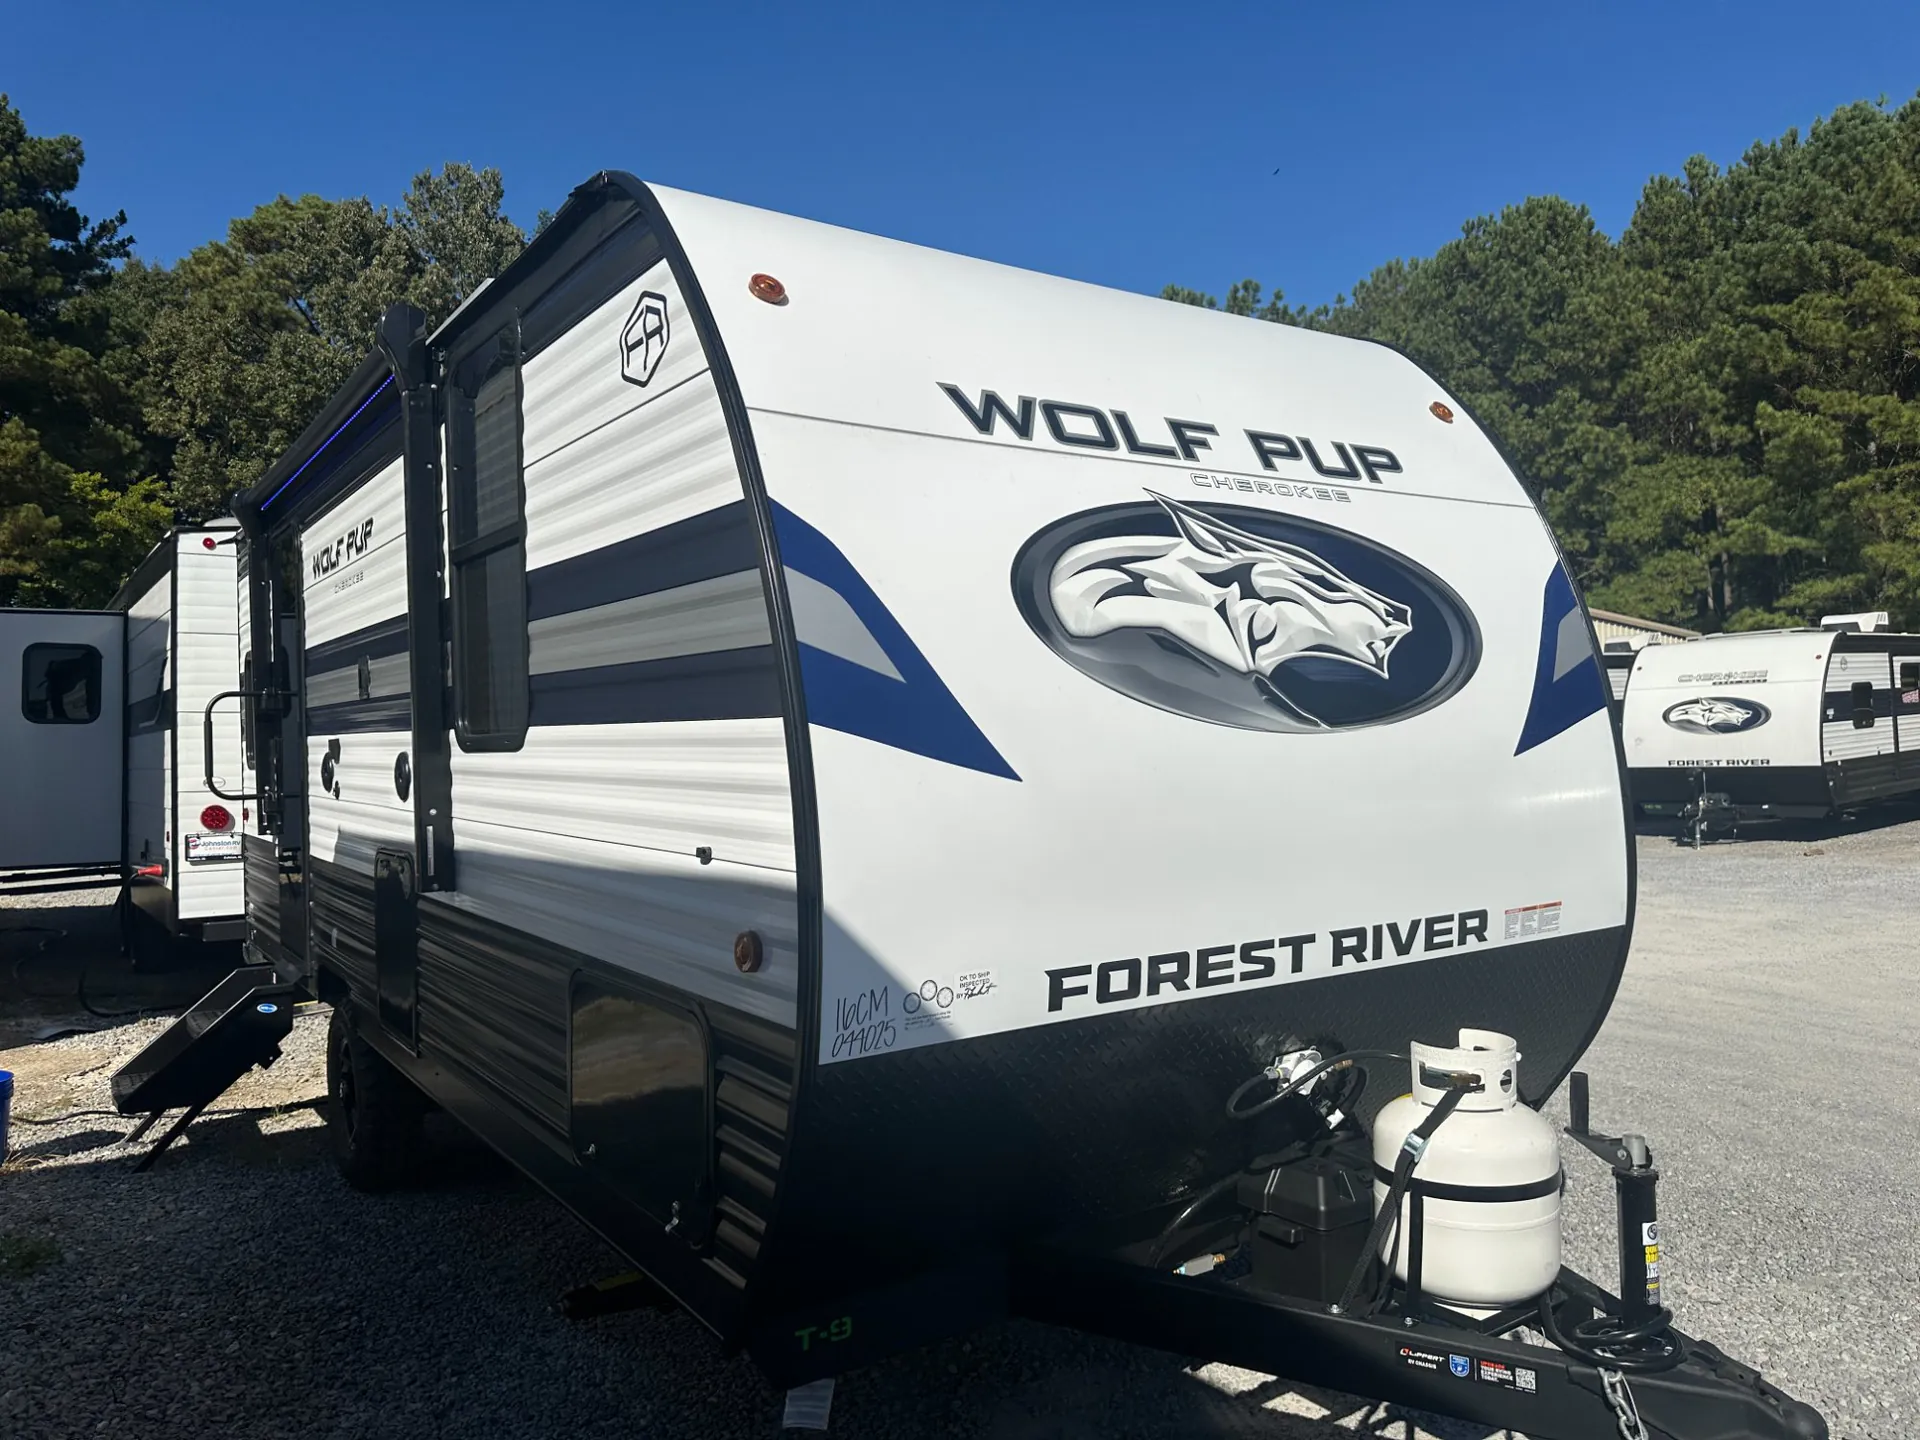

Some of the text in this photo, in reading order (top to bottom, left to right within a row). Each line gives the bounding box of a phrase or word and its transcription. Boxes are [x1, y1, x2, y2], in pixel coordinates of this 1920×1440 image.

[936, 381, 1403, 483] WOLF PUP
[1190, 473, 1351, 502] CHEROKEE
[312, 516, 374, 580] WOLF PUP
[1044, 933, 1316, 1012] FOREST
[1329, 908, 1489, 968] RIVER
[959, 977, 991, 989] INSPECTED
[836, 985, 888, 1033] 16CM
[831, 1018, 896, 1058] 044025
[794, 1316, 852, 1352] T-9
[1409, 1351, 1446, 1363] LIPPERT
